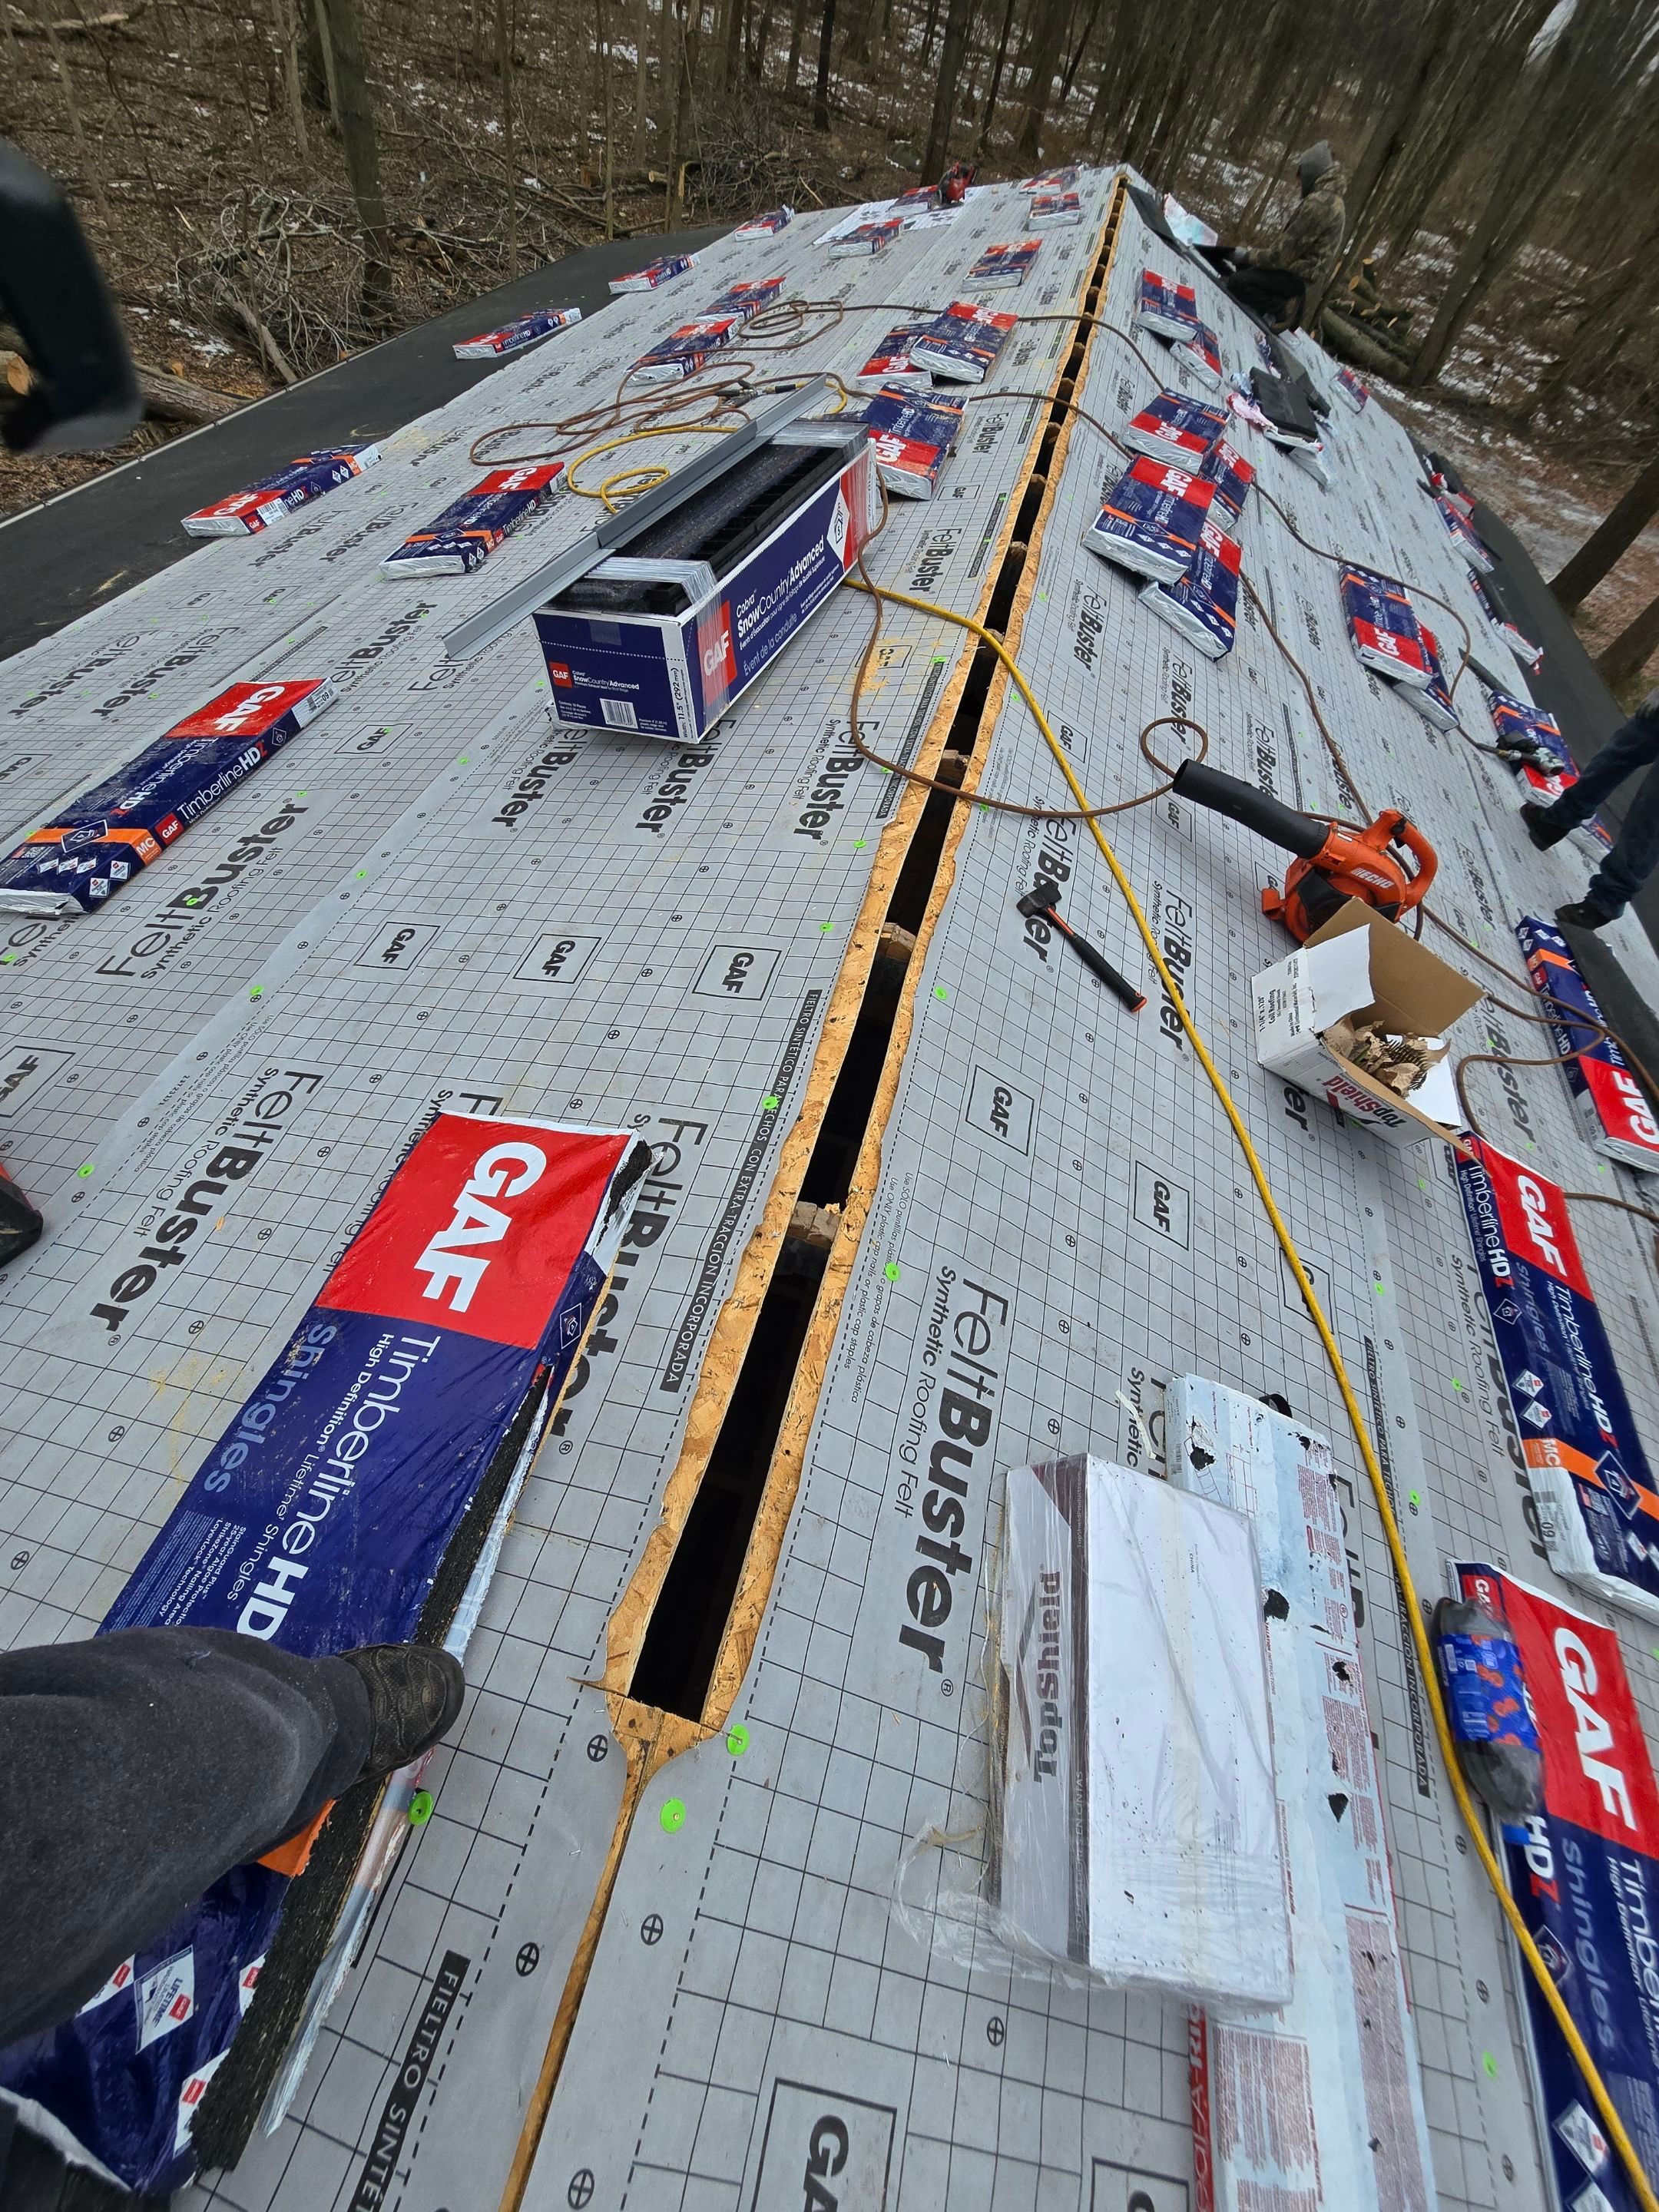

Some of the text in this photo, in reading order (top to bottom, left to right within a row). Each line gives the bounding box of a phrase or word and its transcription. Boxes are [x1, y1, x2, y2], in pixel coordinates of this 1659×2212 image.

[498, 468, 538, 490] GAF
[876, 434, 906, 462] GAF
[1161, 470, 1192, 498] GAF
[909, 528, 962, 592] FeltBuster
[736, 593, 755, 618] Cobra
[1074, 586, 1106, 671] FeltBuster
[330, 602, 438, 684] eltBuster
[552, 670, 568, 680] GAF
[704, 631, 729, 675] GAF
[610, 680, 639, 690] Advanced
[671, 667, 680, 684] mm)
[673, 684, 683, 700] (292
[215, 687, 284, 731] GAF
[1060, 725, 1074, 750] GAF
[492, 729, 588, 827] eltBuster
[502, 777, 519, 790] Felt
[641, 780, 659, 796] Felt
[791, 719, 841, 800] Synthetic Roofing Felt
[135, 837, 154, 856] MC
[162, 822, 179, 840] GAF
[1167, 802, 1180, 829] GAF
[95, 800, 309, 977] FeltBuster
[1152, 880, 1162, 926] Synthetic
[1359, 869, 1395, 889] ECHO
[141, 846, 280, 980] Synthetic Roofing Felt
[382, 926, 416, 965] GAF
[541, 939, 576, 977] GAF
[722, 952, 754, 995] GAF
[800, 994, 819, 1024] FIELTRO
[782, 1027, 806, 1072] SINTÉTICO
[214, 1068, 280, 1140] Synthetic
[989, 1086, 1012, 1138] GAF
[1613, 1071, 1659, 1144] GAF
[154, 1139, 217, 1206] Roofing
[745, 1148, 762, 1172] CON
[1459, 1171, 1469, 1187] High
[91, 1069, 324, 1333] FeltBuster
[132, 1204, 163, 1240] Felt
[414, 1141, 546, 1313] GAF
[705, 1174, 751, 1276] EXTRA-TRACCIÓN
[1152, 1180, 1171, 1232] GAF
[1518, 1175, 1567, 1277] GAF
[844, 1177, 899, 1369] Use ONLY plastic cap nails or plastic cap staples
[851, 1172, 912, 1403] Use SÓLO puntillas grapas de cabeza plástica
[665, 1282, 716, 1382] INCORPORADA
[1521, 1263, 1551, 1353] Shingles
[1365, 1340, 1376, 1382] FIELTRO
[1452, 1254, 1503, 1458] Synthetic Roofing Felt
[204, 1324, 337, 1493] Shingles
[882, 1266, 956, 1518] Synthetic Roofing Felt
[1369, 1385, 1383, 1442] SINTÉTICO
[227, 1333, 395, 1601] High Definition Shingles
[899, 1278, 1009, 1673] FeltBuster
[1542, 1439, 1561, 1466] MC
[159, 1518, 223, 1617] LayerLock Technology
[164, 1522, 232, 1625] StrikeZone Nailing Area
[175, 1525, 240, 1625] 25-year Algae Protectio
[203, 1526, 246, 1594] StainGuard Plus
[1034, 1570, 1060, 1782] TopShield
[1408, 1674, 1429, 1787] INCORPORADA
[1555, 1627, 1638, 1831] GAF
[1562, 1839, 1613, 2048] Shingles
[1607, 1856, 1644, 1992] High Definition
[152, 1978, 183, 2028] LIFETIME
[403, 1971, 459, 2088] FIELTRO
